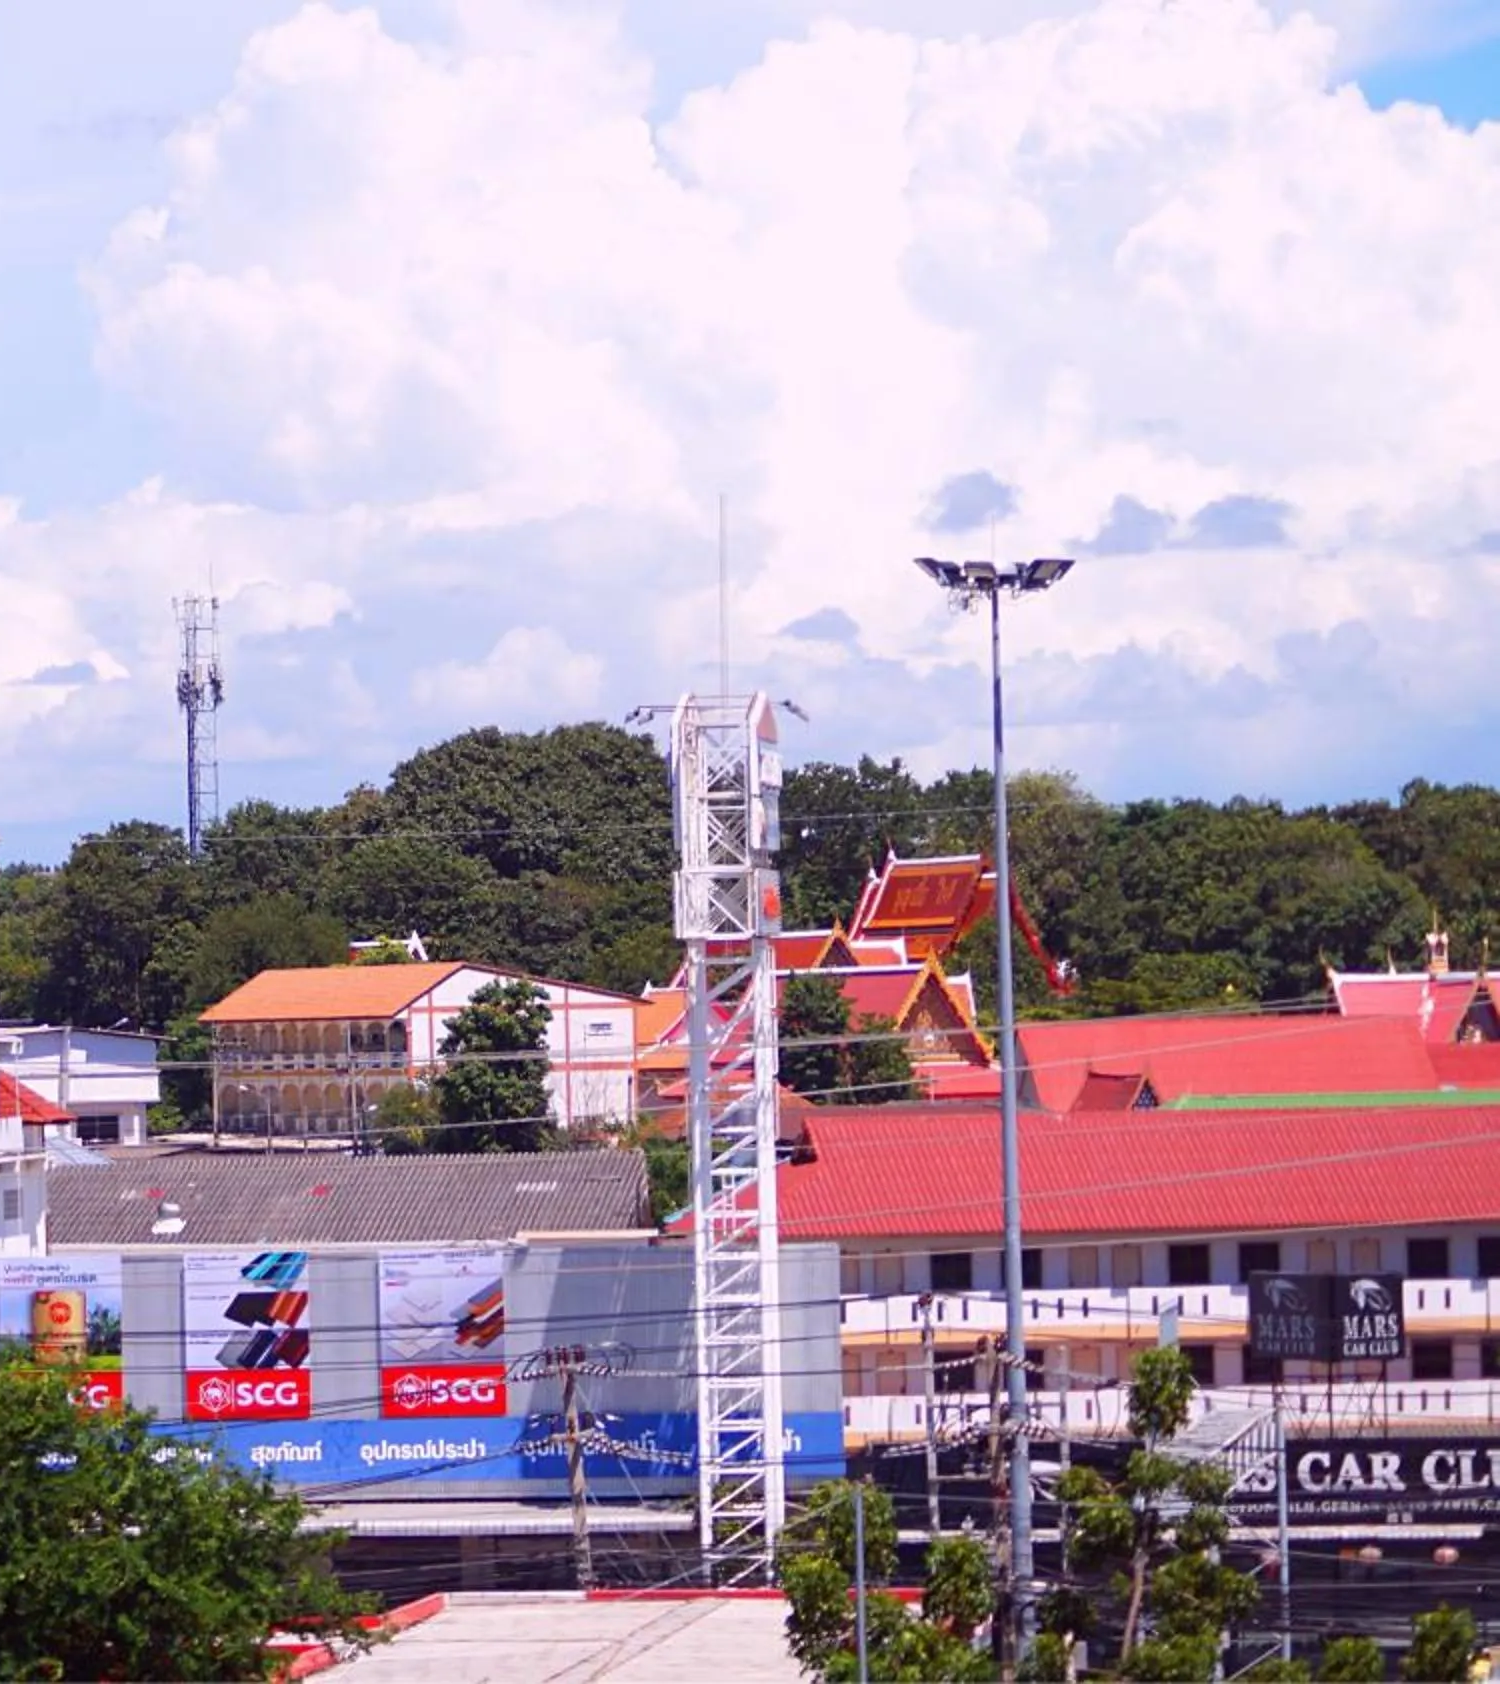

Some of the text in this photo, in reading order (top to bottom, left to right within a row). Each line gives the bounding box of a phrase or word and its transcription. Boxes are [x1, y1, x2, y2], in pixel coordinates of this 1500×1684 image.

[1343, 1314, 1398, 1340] MARS
[1343, 1338, 1399, 1356] CAR CLUB
[67, 1384, 110, 1409] CG
[236, 1382, 299, 1407] SCG
[431, 1378, 495, 1404] SCG
[1297, 1451, 1407, 1492] CAR
